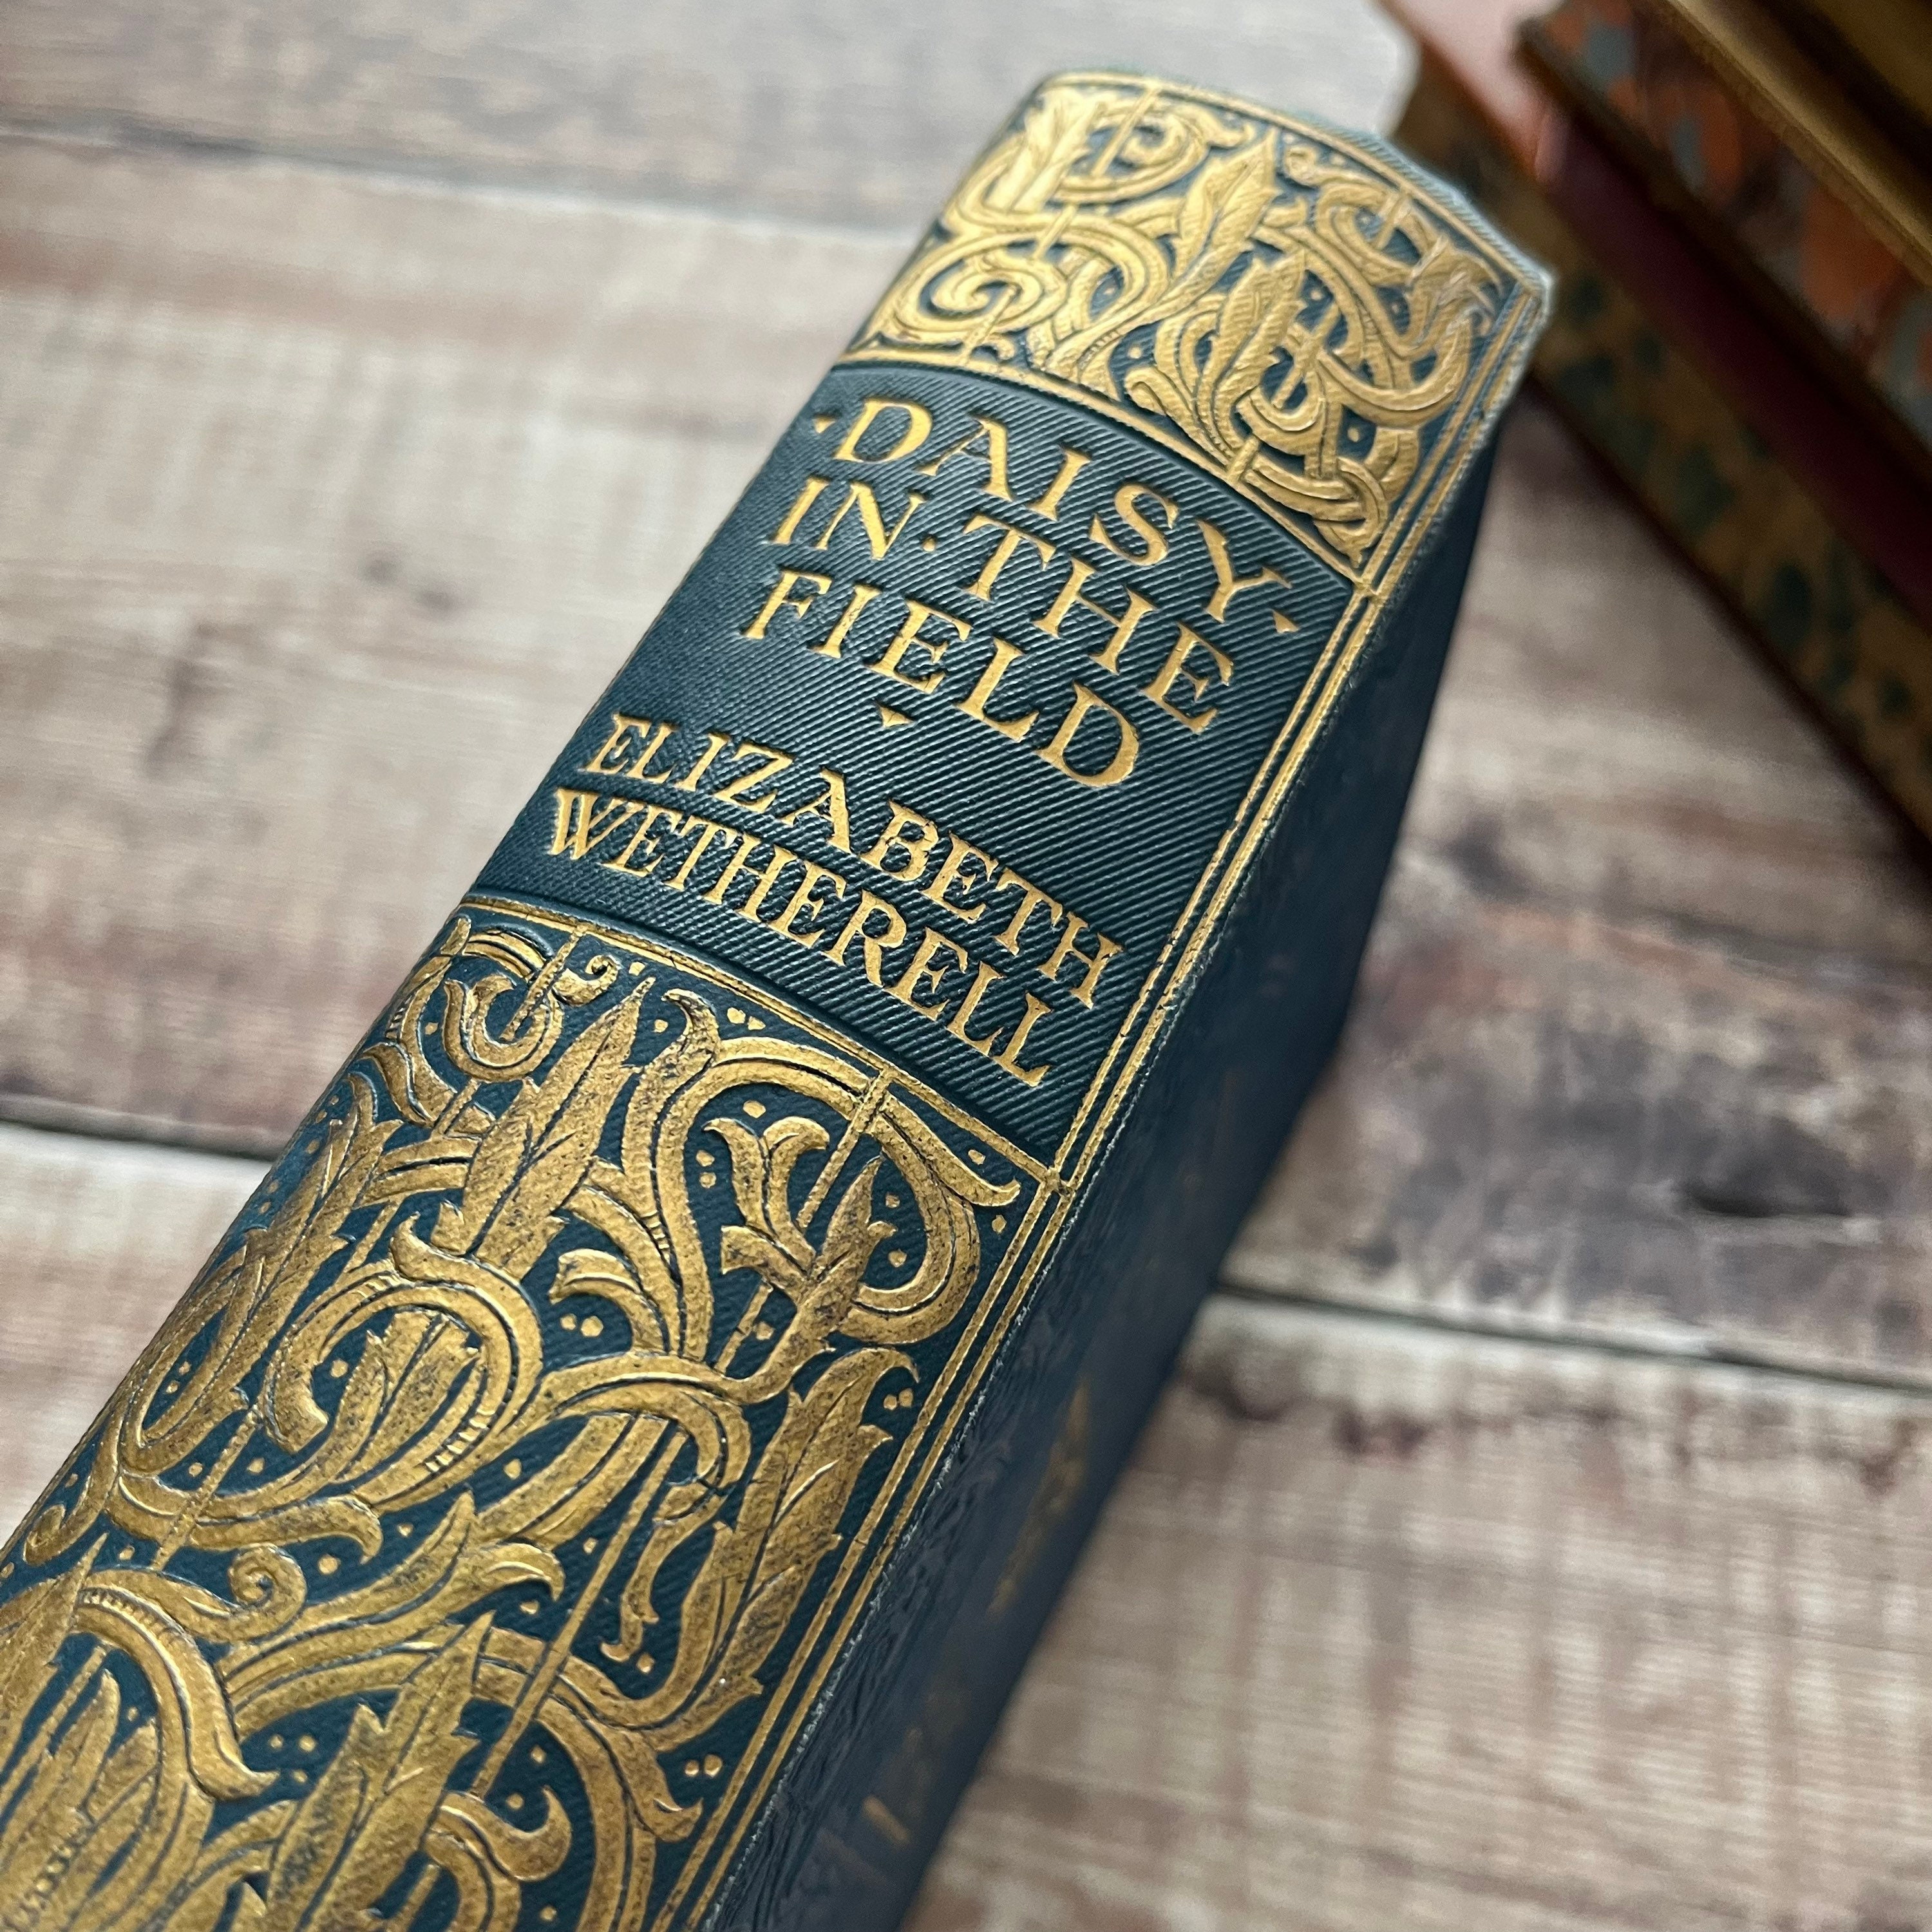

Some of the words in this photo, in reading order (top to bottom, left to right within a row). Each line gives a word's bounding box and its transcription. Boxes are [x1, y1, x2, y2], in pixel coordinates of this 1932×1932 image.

[833, 397, 1293, 622] DAISY
[745, 571, 1140, 787] FIELD
[547, 788, 1057, 1086] WETHERELL
[580, 714, 1125, 1009] ELIZABETH
